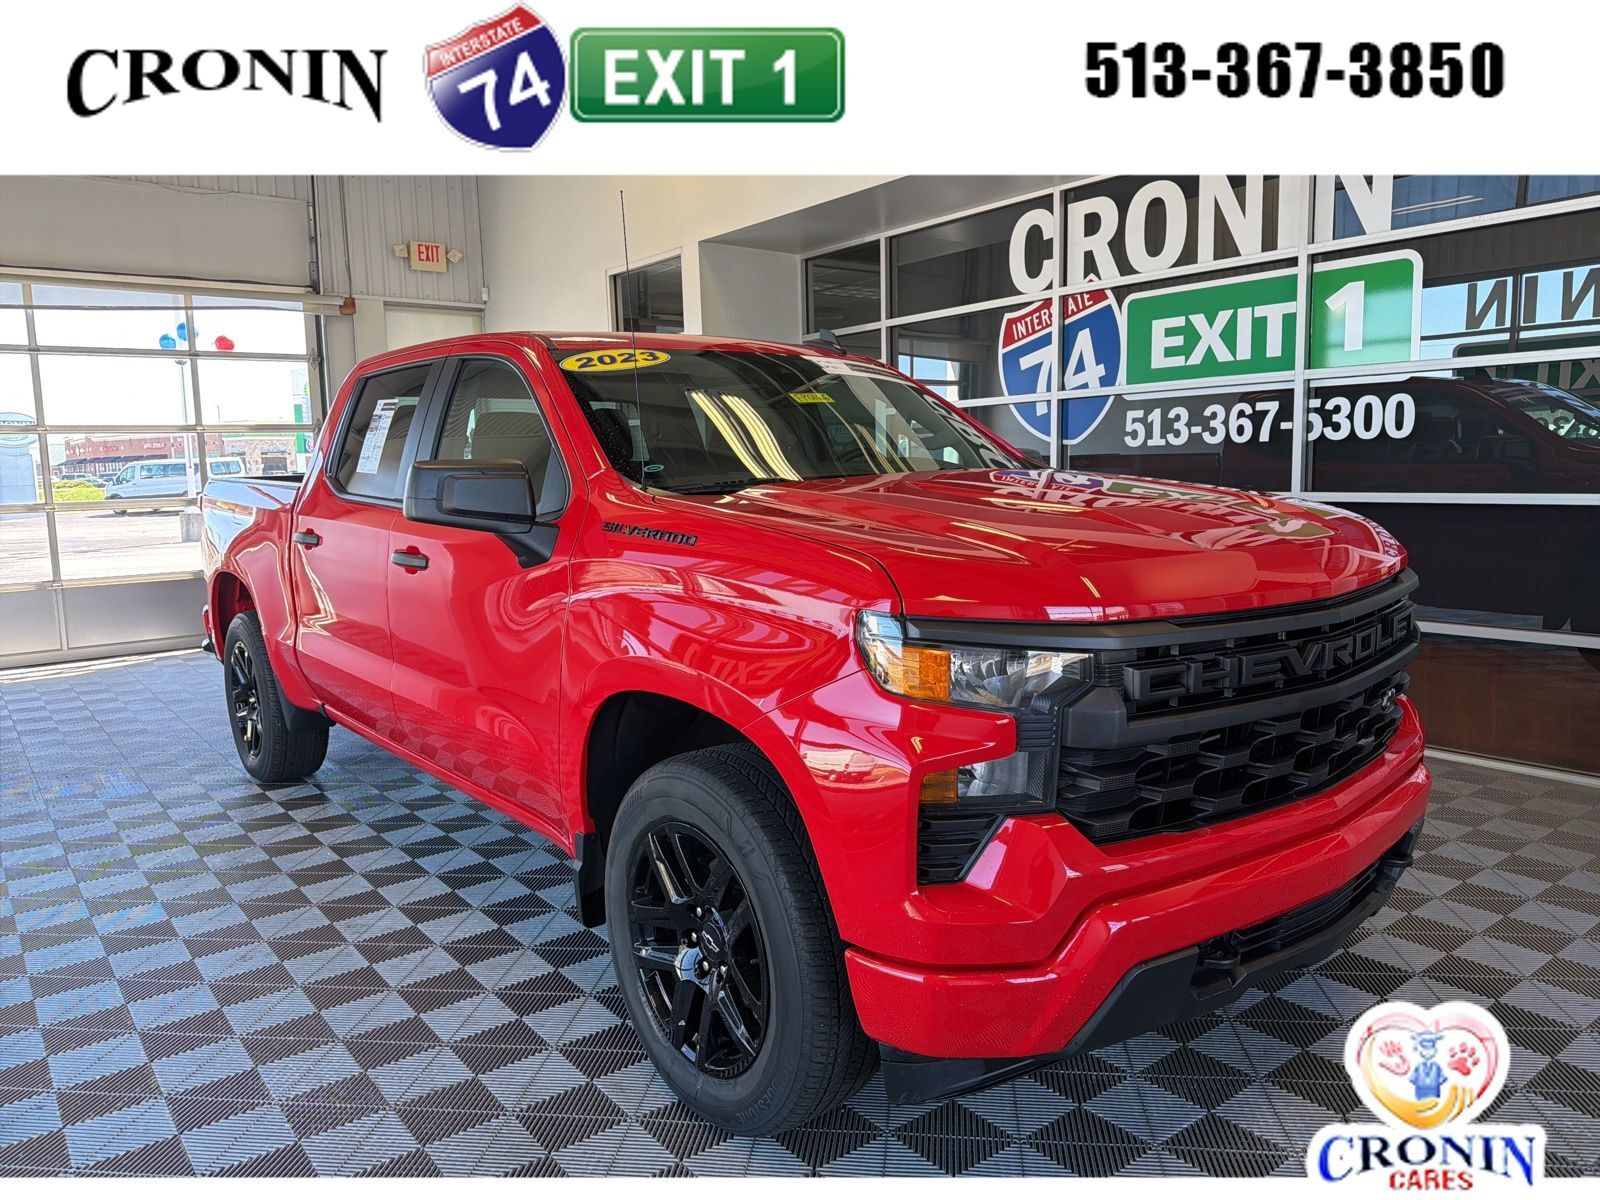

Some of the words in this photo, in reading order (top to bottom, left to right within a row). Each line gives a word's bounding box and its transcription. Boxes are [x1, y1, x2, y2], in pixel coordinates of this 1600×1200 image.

[417, 243, 441, 263] EXIT
[1009, 175, 1393, 293] CRONIN
[1012, 292, 1095, 341] INTERATE
[1150, 300, 1297, 370] EXIT
[1323, 280, 1366, 352] 1
[575, 351, 660, 369] 2023
[1018, 327, 1107, 417] 74
[1124, 393, 1415, 448] 513-367-5300
[602, 520, 698, 547] SILVERADO
